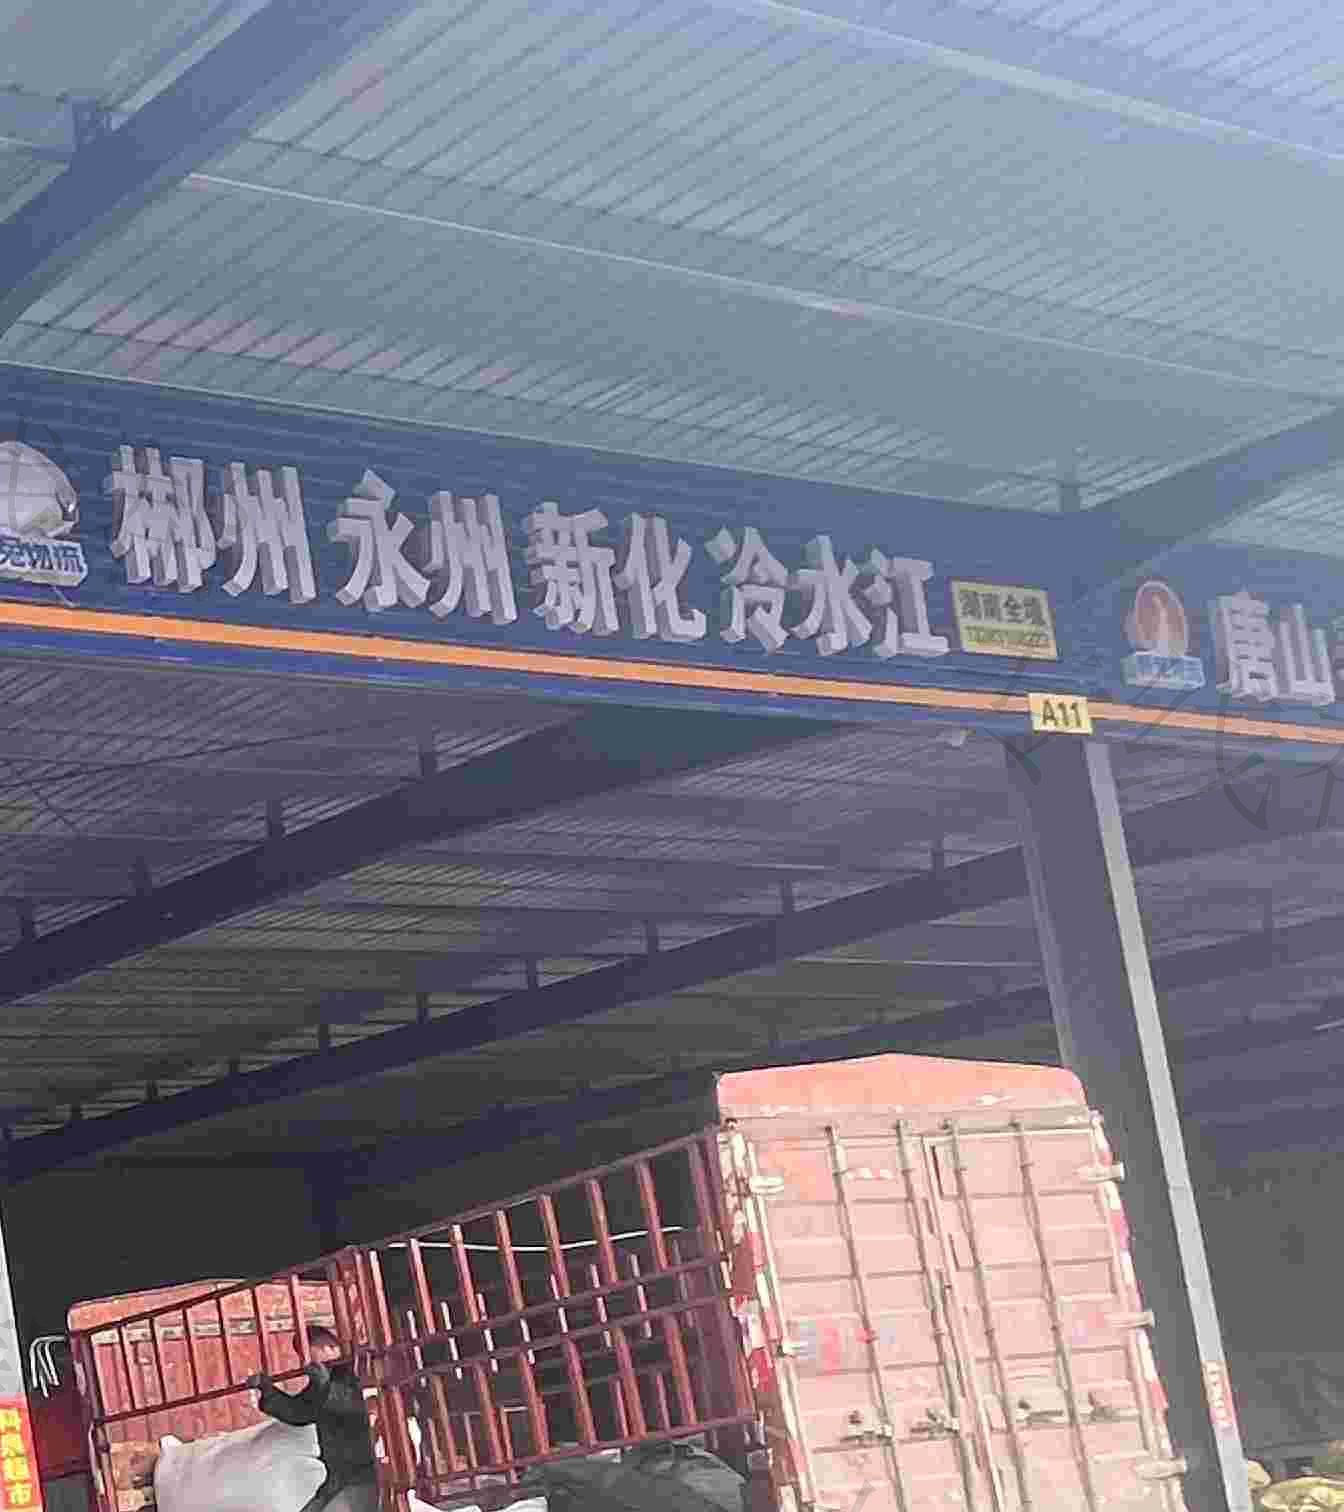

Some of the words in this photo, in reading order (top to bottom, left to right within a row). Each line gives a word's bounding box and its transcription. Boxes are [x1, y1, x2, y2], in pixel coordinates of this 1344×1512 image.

[105, 444, 317, 604] 郴州
[328, 467, 518, 625] 永州
[521, 500, 707, 642] 新化
[705, 525, 951, 660] 冷水江
[1215, 585, 1337, 706] 唐山
[1041, 700, 1083, 728] A11
